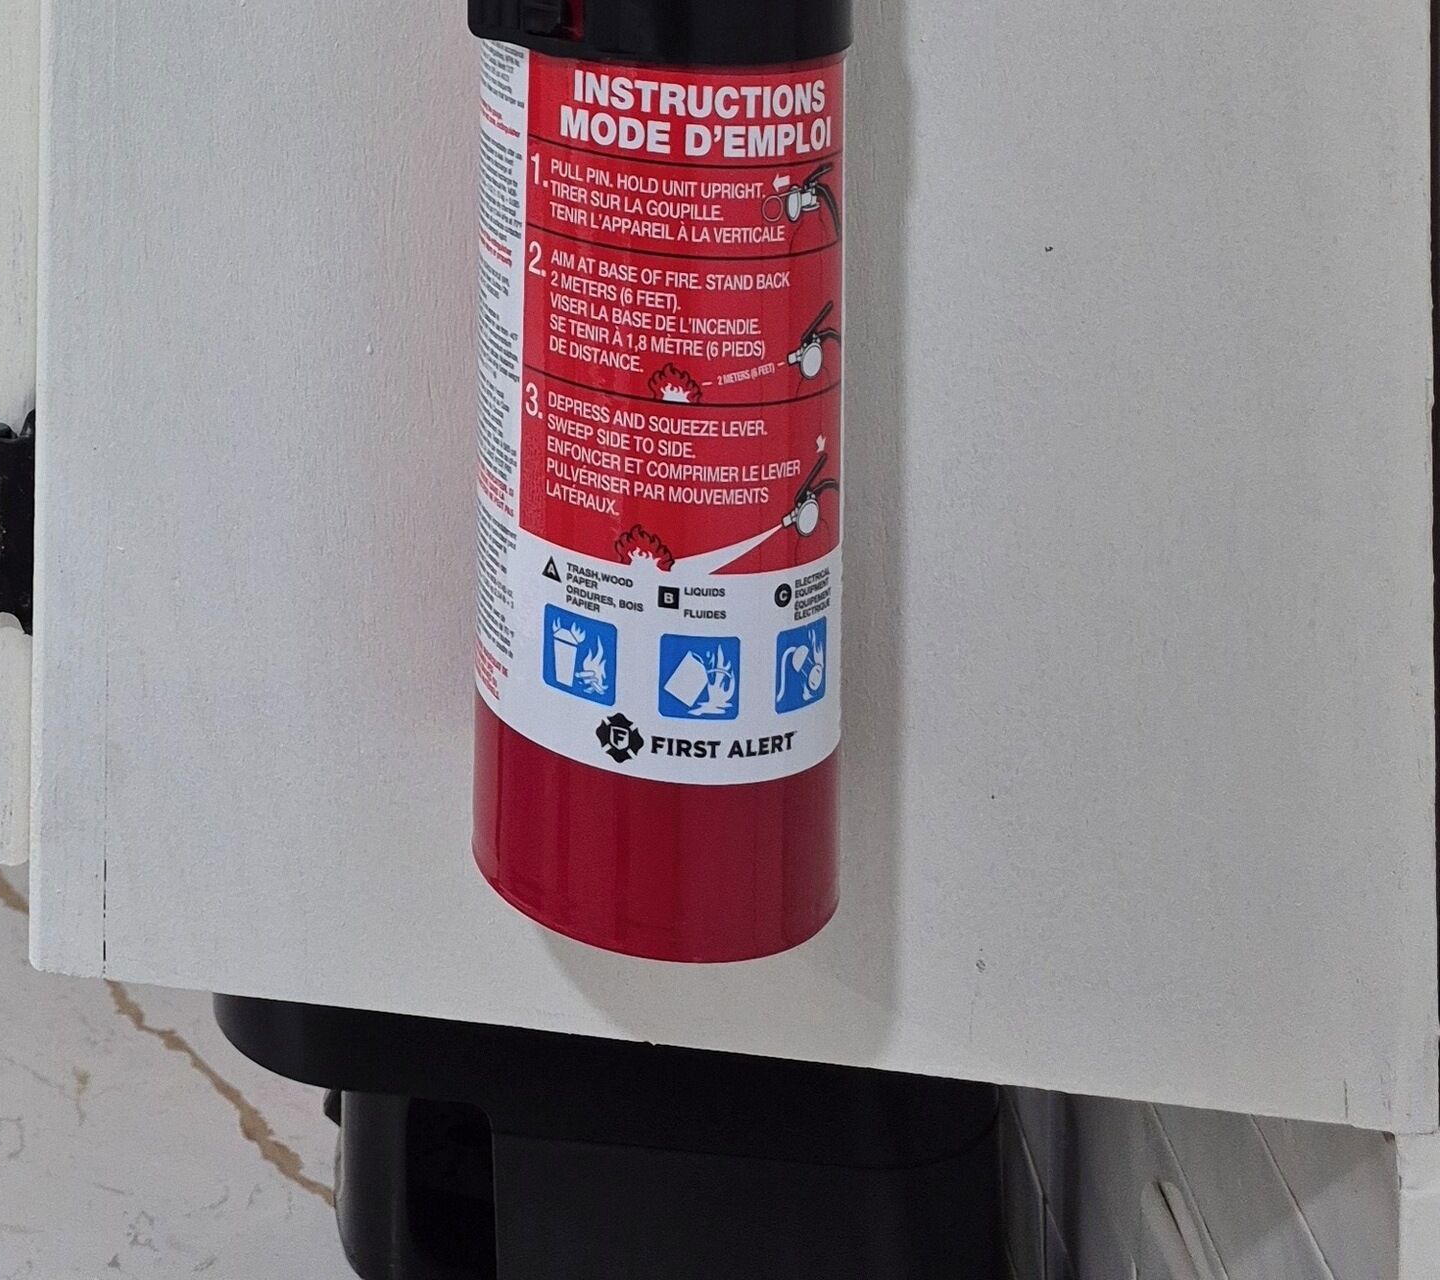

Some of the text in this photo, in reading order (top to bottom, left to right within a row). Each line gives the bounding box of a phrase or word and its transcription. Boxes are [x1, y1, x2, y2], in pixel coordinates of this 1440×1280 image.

[574, 70, 825, 119] INSTRUCTIONS
[560, 105, 671, 155] MODE
[685, 116, 831, 158] D'EMPLOI
[531, 153, 548, 188] 1.
[550, 159, 766, 200] PULL PIN. HOLD UNIT UPRIGHT.
[550, 180, 723, 221] TIRER SUR LA GOUPILLE.
[550, 201, 785, 243] TENIR L'APPAREIL À LA VERTICALE
[528, 240, 546, 278] 2.
[551, 249, 790, 290] AIM AT BASE OF FIRE. STAND BACK
[550, 271, 681, 313] 2 METERS (6 FEET).
[550, 293, 762, 335] VISER LA BASE DE L'INCENDIE.
[549, 336, 644, 373] DE DISTANCE.
[550, 314, 765, 360] SE TENIR À 1,8 MÈTRE (6 PIEDS)
[717, 375, 723, 385] 2
[723, 369, 750, 384] METERS
[758, 362, 775, 376] FEET)
[525, 382, 543, 419] 3.
[548, 391, 767, 437] DEPRESS AND SQUEEZE LEVER.
[547, 414, 696, 459] SWEEP SIDE TO SIDE.
[547, 436, 801, 483] ENFONCER ET COMPRIMER LE LEVIER
[546, 457, 769, 505] PULVÉRISER PAR MOUVEMENTS
[546, 480, 620, 517] LATÉRAUX.
[566, 574, 598, 590] PAPER
[684, 587, 725, 598] LIQUIDS
[795, 567, 830, 588] ELECTRICAL
[566, 585, 644, 612] ORDURES, BOIS
[566, 595, 600, 613] PAPIER
[664, 592, 673, 604] B
[684, 610, 726, 620] FLUIDES
[612, 729, 627, 745] F
[651, 731, 795, 758] FIRST ALERT
